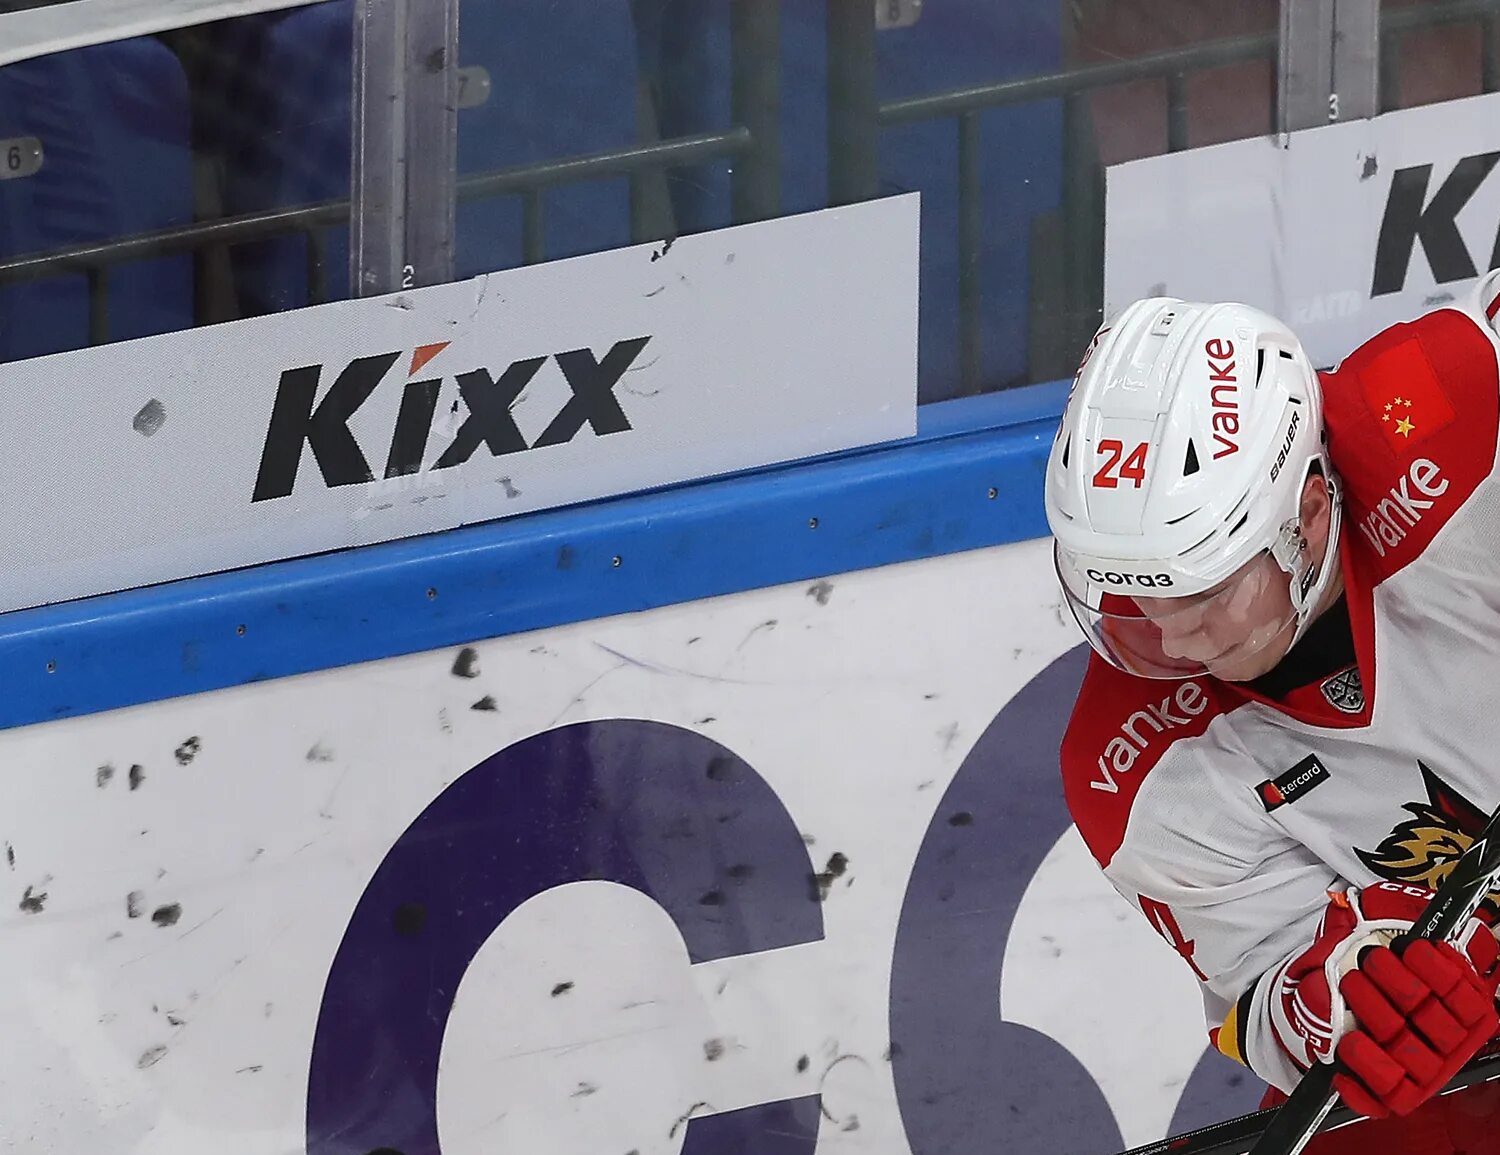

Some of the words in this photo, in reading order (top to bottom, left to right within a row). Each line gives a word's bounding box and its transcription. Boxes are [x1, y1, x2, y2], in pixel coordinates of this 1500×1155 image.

[1328, 95, 1340, 120] 3
[8, 147, 20, 170] 6
[402, 264, 415, 288] 2
[251, 336, 653, 503] Kixx
[1205, 337, 1241, 460] vanke
[1091, 438, 1150, 490] 24
[1359, 457, 1450, 558] vanke
[1089, 681, 1209, 795] vanke
[1279, 762, 1322, 796] tercard
